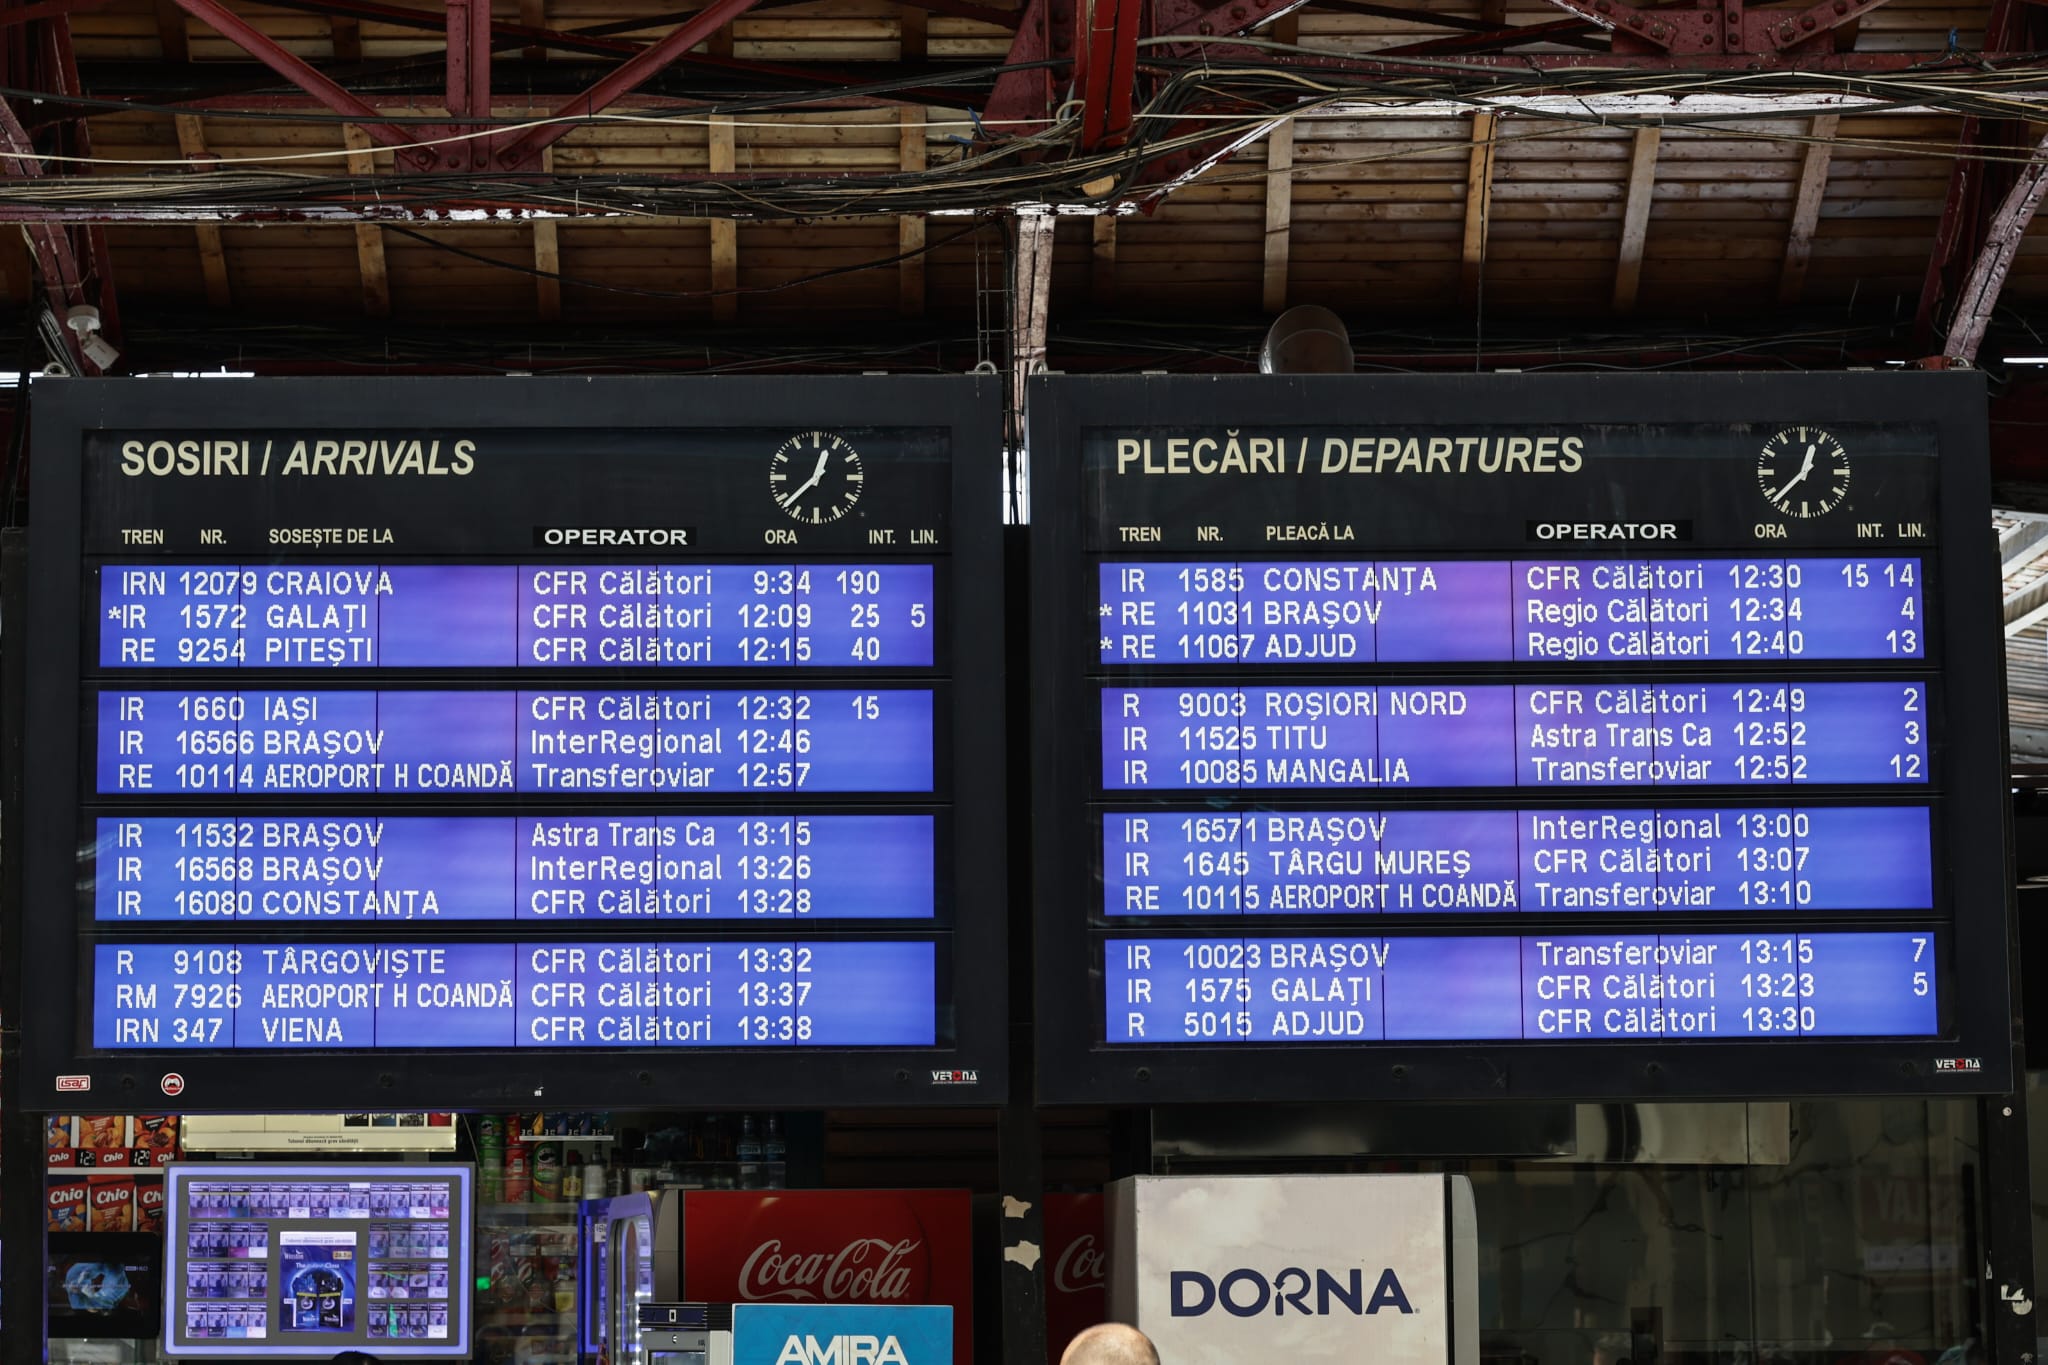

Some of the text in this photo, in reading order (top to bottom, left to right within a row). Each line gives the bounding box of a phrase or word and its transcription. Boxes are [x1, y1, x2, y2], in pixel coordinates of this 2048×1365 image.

[121, 440, 475, 476] SOSIRI ARRIVALS
[1118, 430, 1583, 474] PLECĂRI DEPARTURES
[122, 530, 163, 544] TREN
[201, 530, 226, 544] NR.
[348, 529, 368, 543] DE
[373, 529, 393, 543] LA
[545, 529, 687, 545] OPERATOR
[765, 530, 797, 544] ORA
[869, 530, 895, 544] INT.
[911, 530, 938, 543] LIN.
[1119, 522, 1925, 541] TREN NR. PLEACĂ LA OPERATOR ORA INT. LIN.
[124, 571, 879, 595] IRN 12079 CRAIOVA CFR 9:34 190
[1179, 568, 1244, 592] 1585
[1730, 565, 1800, 588] 12:30
[1842, 564, 1868, 587] 15
[1885, 564, 1913, 587] 14
[181, 605, 246, 628] 1572
[739, 604, 810, 627] 12:09
[851, 604, 879, 627] 25
[912, 604, 925, 627] 5
[1123, 602, 1155, 625] RE
[1178, 601, 1251, 625] 11031
[1528, 598, 1597, 627] Regio
[1608, 597, 1707, 622] Călători
[1731, 598, 1802, 621] 12:34
[1902, 597, 1914, 619] 4
[123, 639, 155, 661] RE
[179, 638, 245, 661] 9254
[739, 638, 810, 660] 12:15
[852, 637, 879, 660] 40
[1123, 630, 1915, 660] RE 11067 ADJUD Regio Călători 12:40 13
[179, 697, 244, 720] 1660
[738, 696, 810, 719] 12:32
[853, 696, 879, 719] 15
[1180, 693, 1246, 716] 9003
[1391, 692, 1466, 715] NORD
[1733, 689, 1804, 712] 12:49
[1904, 688, 1917, 711] 2
[177, 731, 254, 754] 16566
[532, 728, 721, 758] InterRegional
[738, 729, 810, 753] 12:46
[1180, 721, 1918, 750] 11525 TITU Astra Trans Ca 12:52 3
[120, 760, 810, 787] RE 10114 AEROPORT COANDĂ Transferoviar 12:57
[1181, 755, 1920, 783] 10085 MANGALIA Transferoviar 12:52 12
[176, 824, 253, 847] 11532
[532, 823, 598, 846] Astra
[609, 823, 675, 846] Trans
[686, 822, 714, 845] Ca
[738, 822, 810, 845] 13:15
[1182, 818, 1255, 842] 16571
[1533, 814, 1720, 844] InterRegional
[1737, 814, 1808, 837] 13:00
[176, 857, 252, 881] 16568
[532, 854, 721, 884] InterRegional
[738, 856, 810, 879] 13:26
[1184, 852, 1248, 875] 1645
[1269, 848, 1361, 875] TÂRGU
[1738, 847, 1809, 871] 13:07
[175, 891, 252, 914] 16080
[738, 889, 810, 912] 13:28
[1127, 880, 1810, 909] RE 10115 AEROPORT COANDĂ Transferoviar 13:10
[175, 947, 811, 978] 9108 TÂRGOVIȘTE 13:32
[1184, 945, 1260, 968] 10023
[1537, 939, 1717, 965] Transferoviar
[1741, 940, 1812, 963] 13:15
[1913, 939, 1925, 961] 7
[117, 980, 811, 1008] RM 7926 AEROPORT COANDĂ 13:37
[1186, 978, 1251, 1002] 1575
[1742, 973, 1814, 997] 13:23
[1914, 972, 1927, 995] 5
[117, 1016, 811, 1042] IRN 347 VIENA 13:38
[1185, 1007, 1814, 1036] 5015 ADJUD CFR 13:30
[932, 1071, 977, 1081] VERONA
[1936, 1058, 1981, 1069] VERONA
[49, 1152, 123, 1163] Chio Chio
[50, 1188, 83, 1205] Chio
[96, 1187, 128, 1204] Chio
[738, 1238, 922, 1300] Coca-Cola
[1170, 1267, 1413, 1317] DORNA
[776, 1334, 908, 1365] AMIRA
